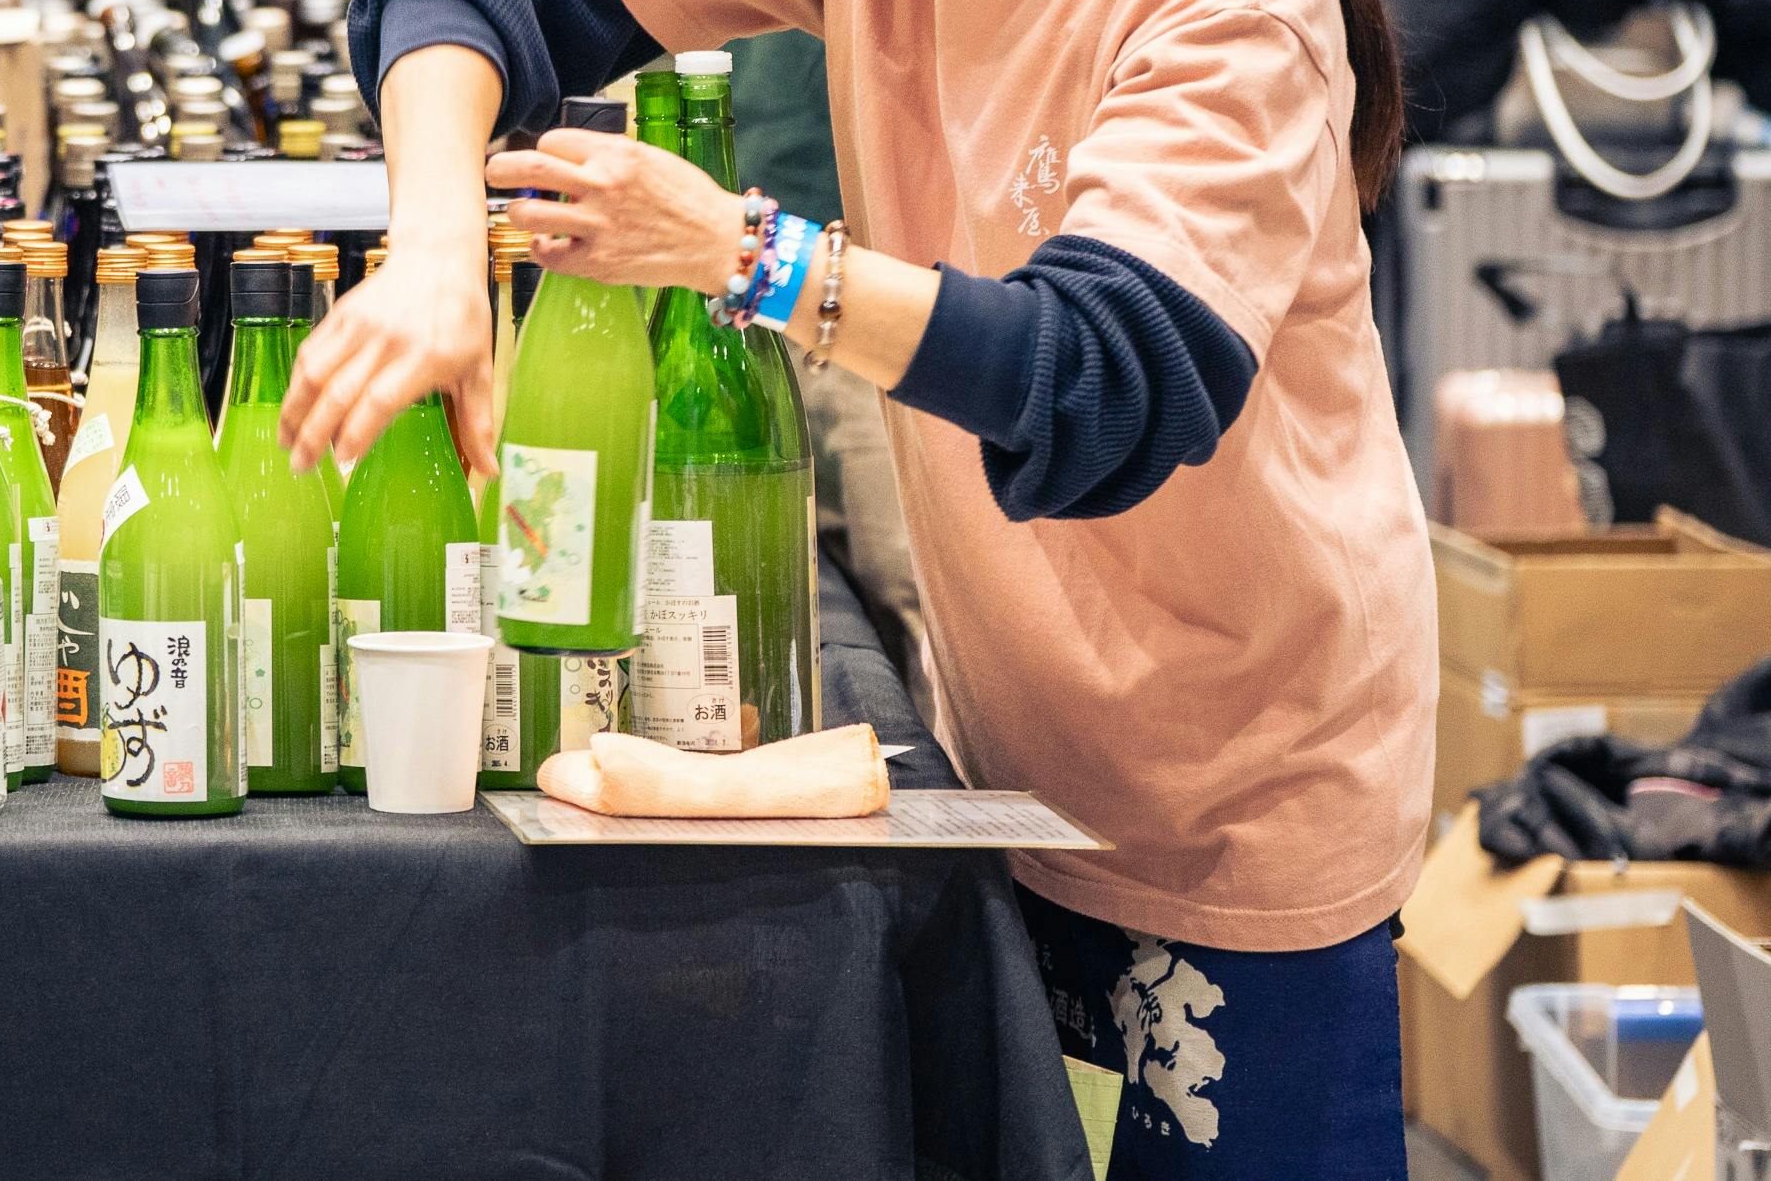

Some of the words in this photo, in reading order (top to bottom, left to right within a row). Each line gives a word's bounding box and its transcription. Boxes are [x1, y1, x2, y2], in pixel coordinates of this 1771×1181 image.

[107, 637, 168, 788] ゆず
[694, 703, 727, 721] お酒
[484, 734, 509, 752] お酒
